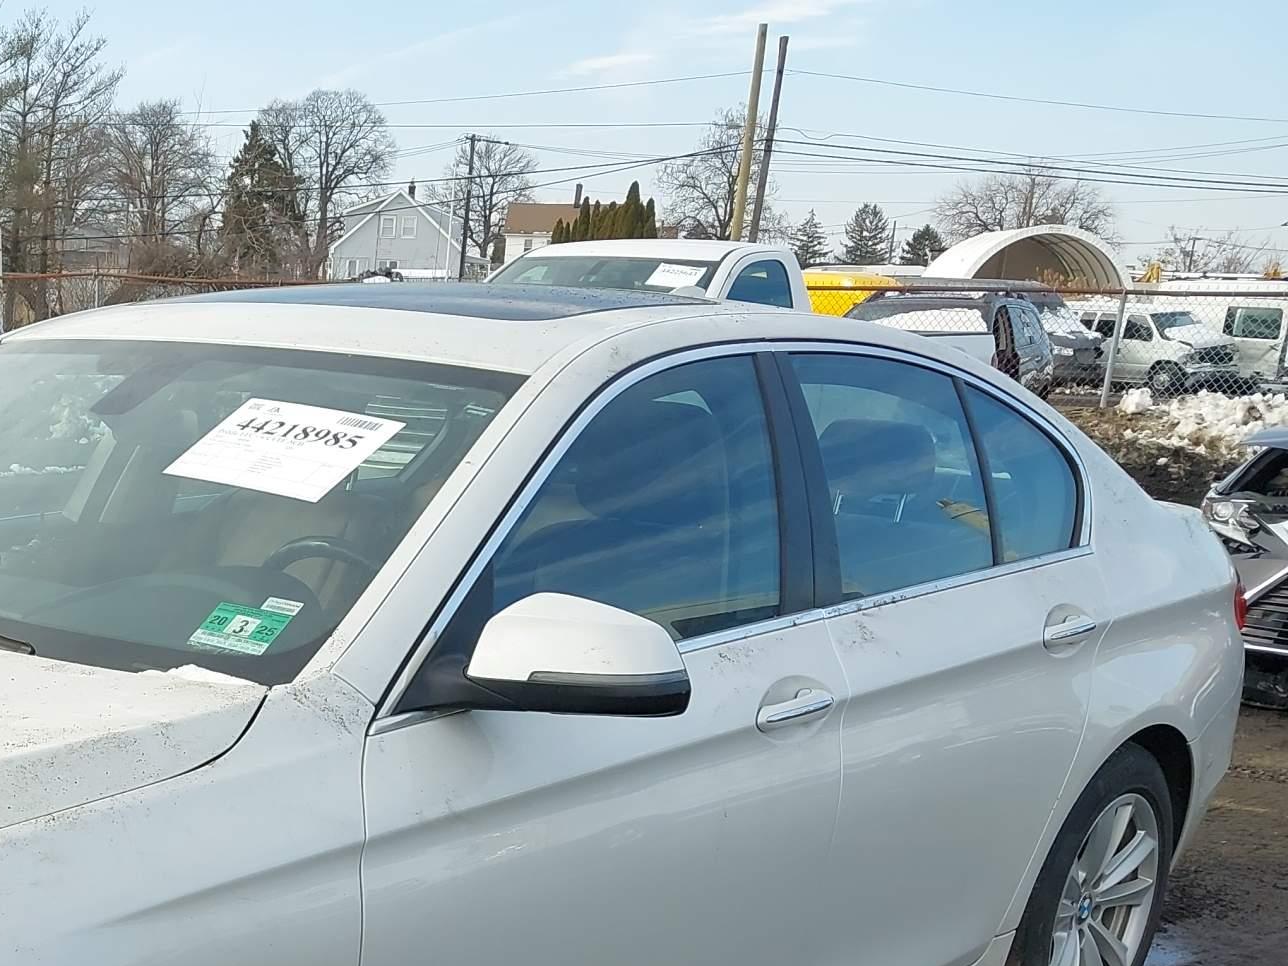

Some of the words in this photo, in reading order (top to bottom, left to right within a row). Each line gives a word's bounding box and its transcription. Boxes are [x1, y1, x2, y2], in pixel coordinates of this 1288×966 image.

[236, 416, 365, 449] 44218985
[209, 615, 228, 626] 20
[232, 620, 249, 634] 3
[256, 625, 277, 636] 25
